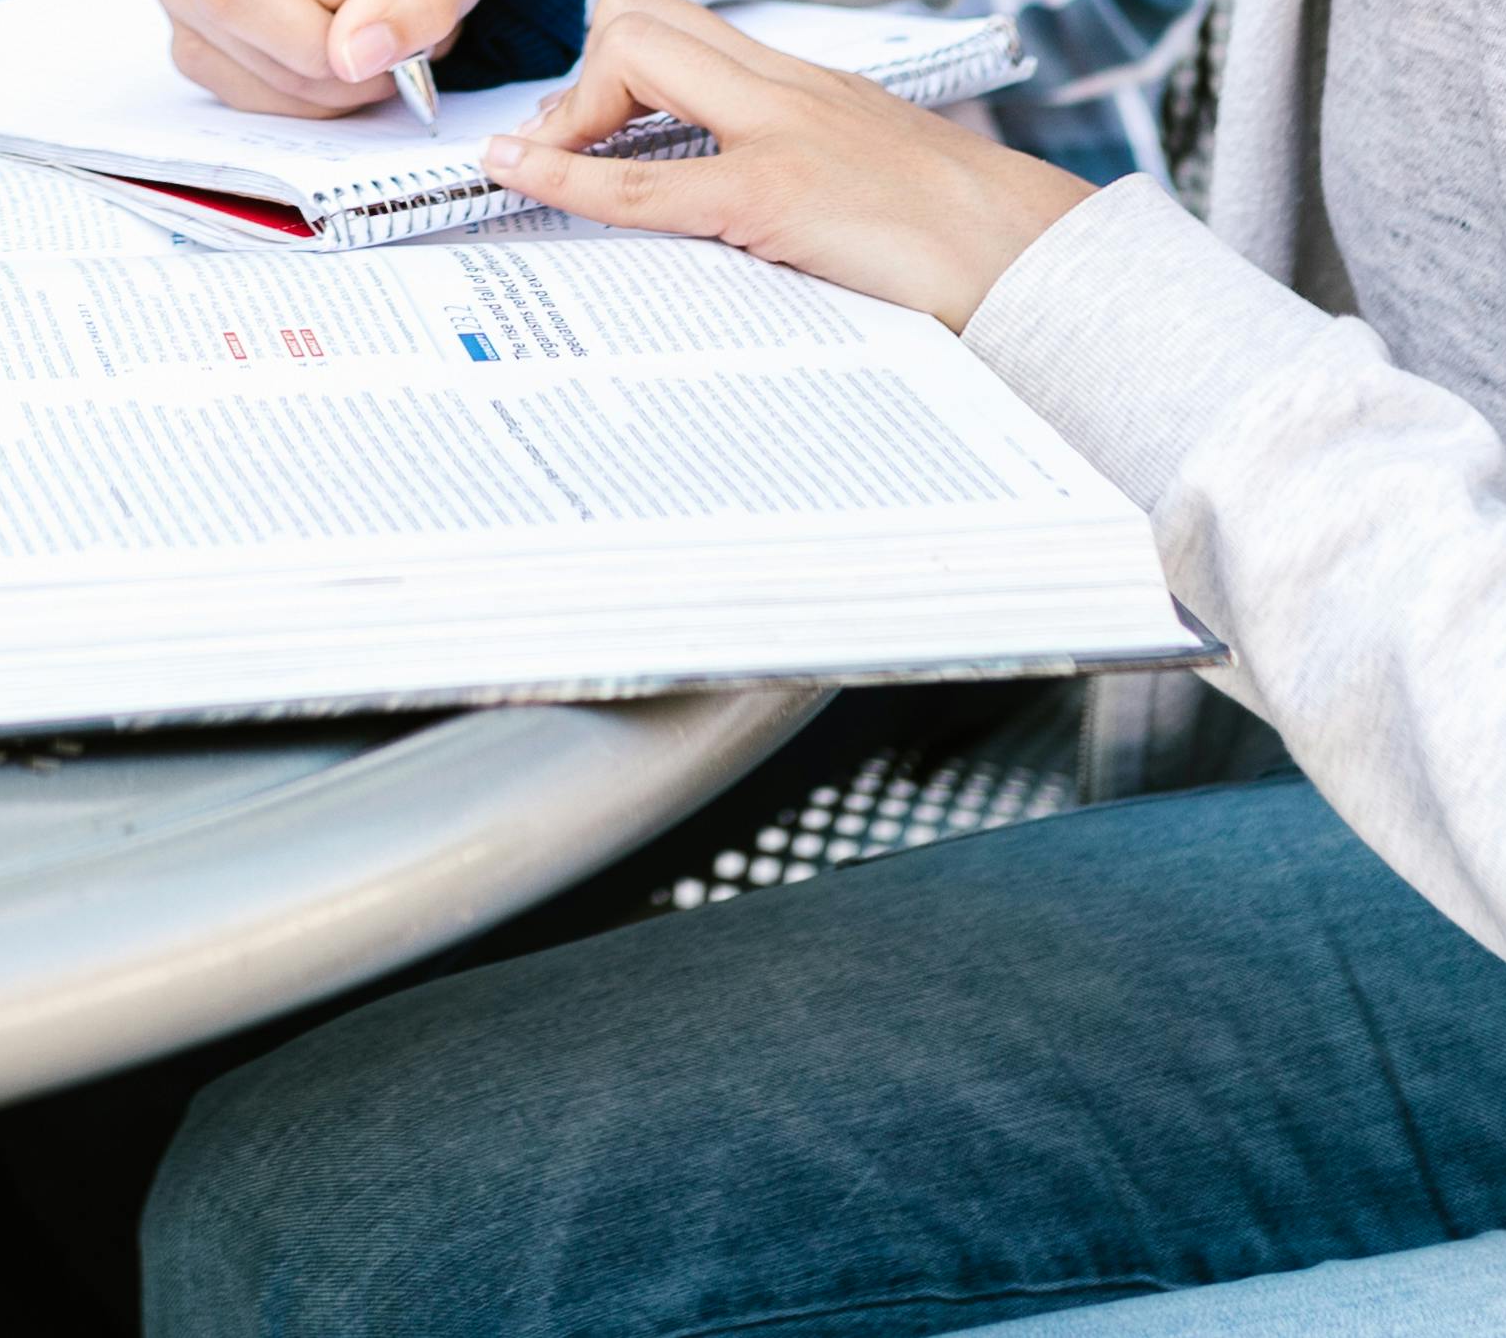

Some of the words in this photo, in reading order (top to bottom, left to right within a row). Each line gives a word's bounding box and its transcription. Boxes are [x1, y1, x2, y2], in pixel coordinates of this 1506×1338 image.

[472, 286, 496, 303] fall
[500, 278, 529, 310] reflect
[534, 290, 556, 310] and
[443, 304, 485, 331] 23.2
[487, 303, 510, 322] and
[500, 324, 521, 341] rise
[519, 311, 561, 360] organisms
[546, 310, 588, 358] speciation
[512, 343, 534, 361] The
